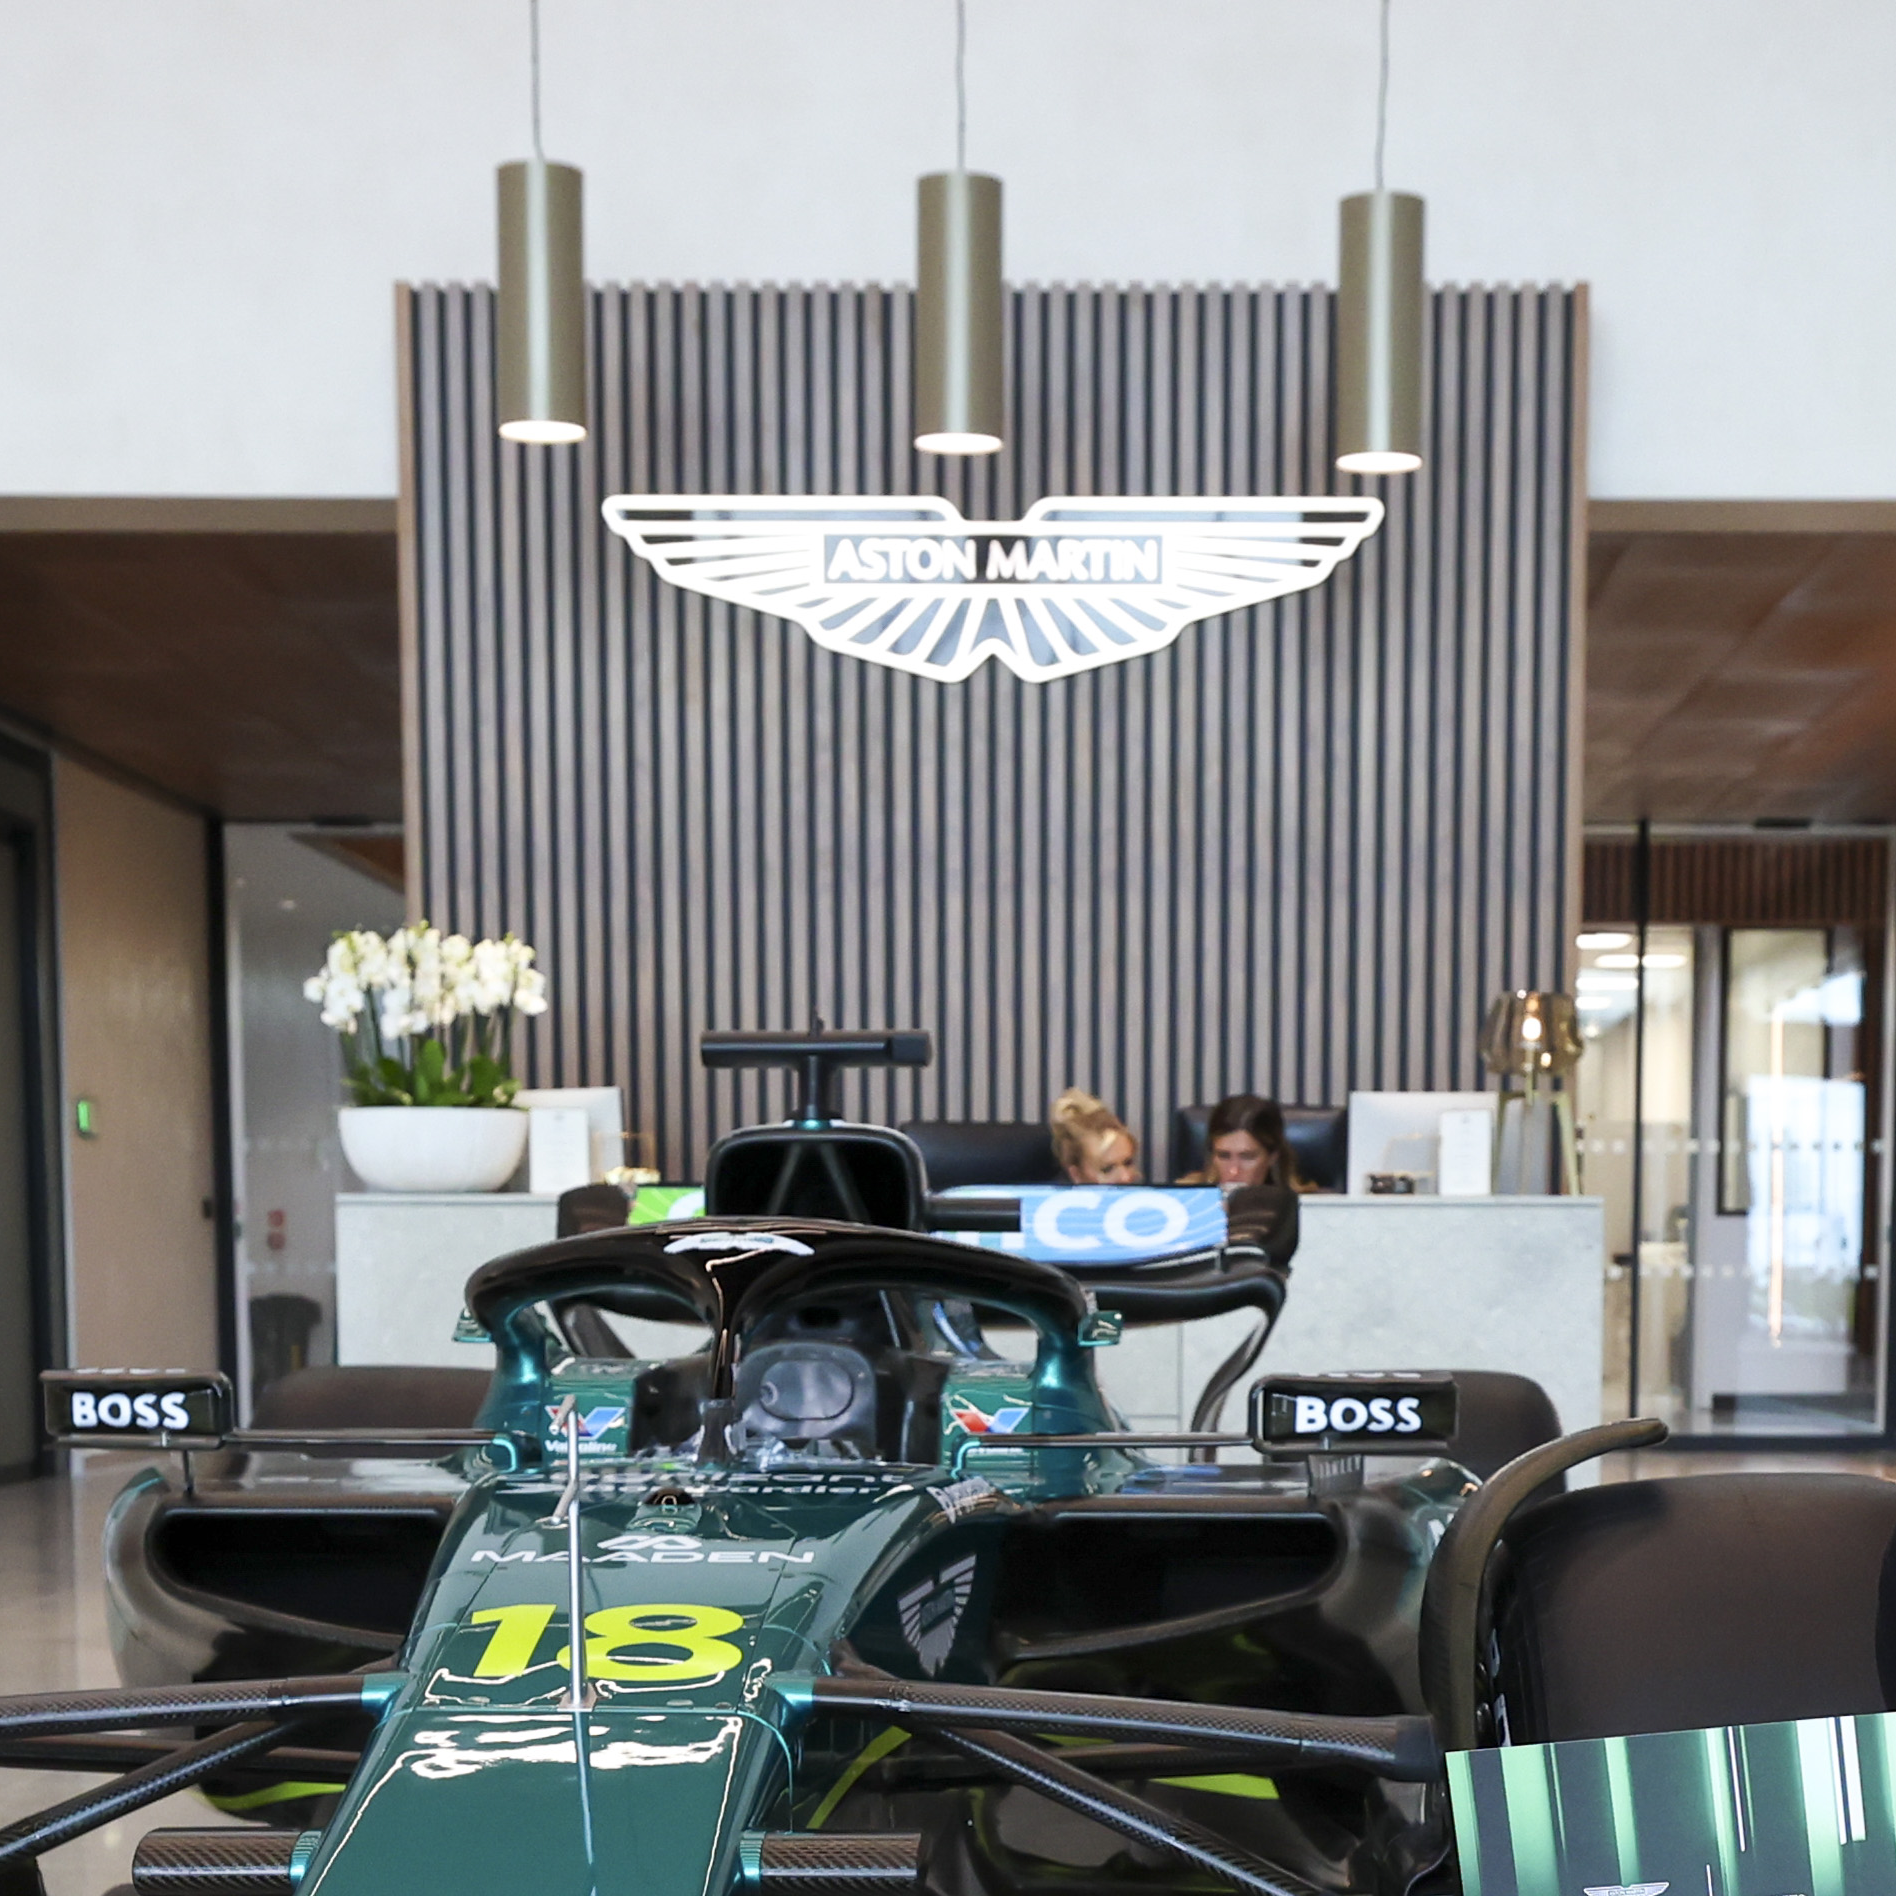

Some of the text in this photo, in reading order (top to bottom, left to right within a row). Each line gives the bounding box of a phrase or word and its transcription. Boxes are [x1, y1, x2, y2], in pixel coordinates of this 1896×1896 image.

[828, 539, 1158, 583] ASTON MARTIN
[71, 1391, 190, 1430] BOSS
[1294, 1395, 1423, 1433] BOSS
[469, 1549, 816, 1564] MAADEN
[469, 1603, 744, 1682] 18
